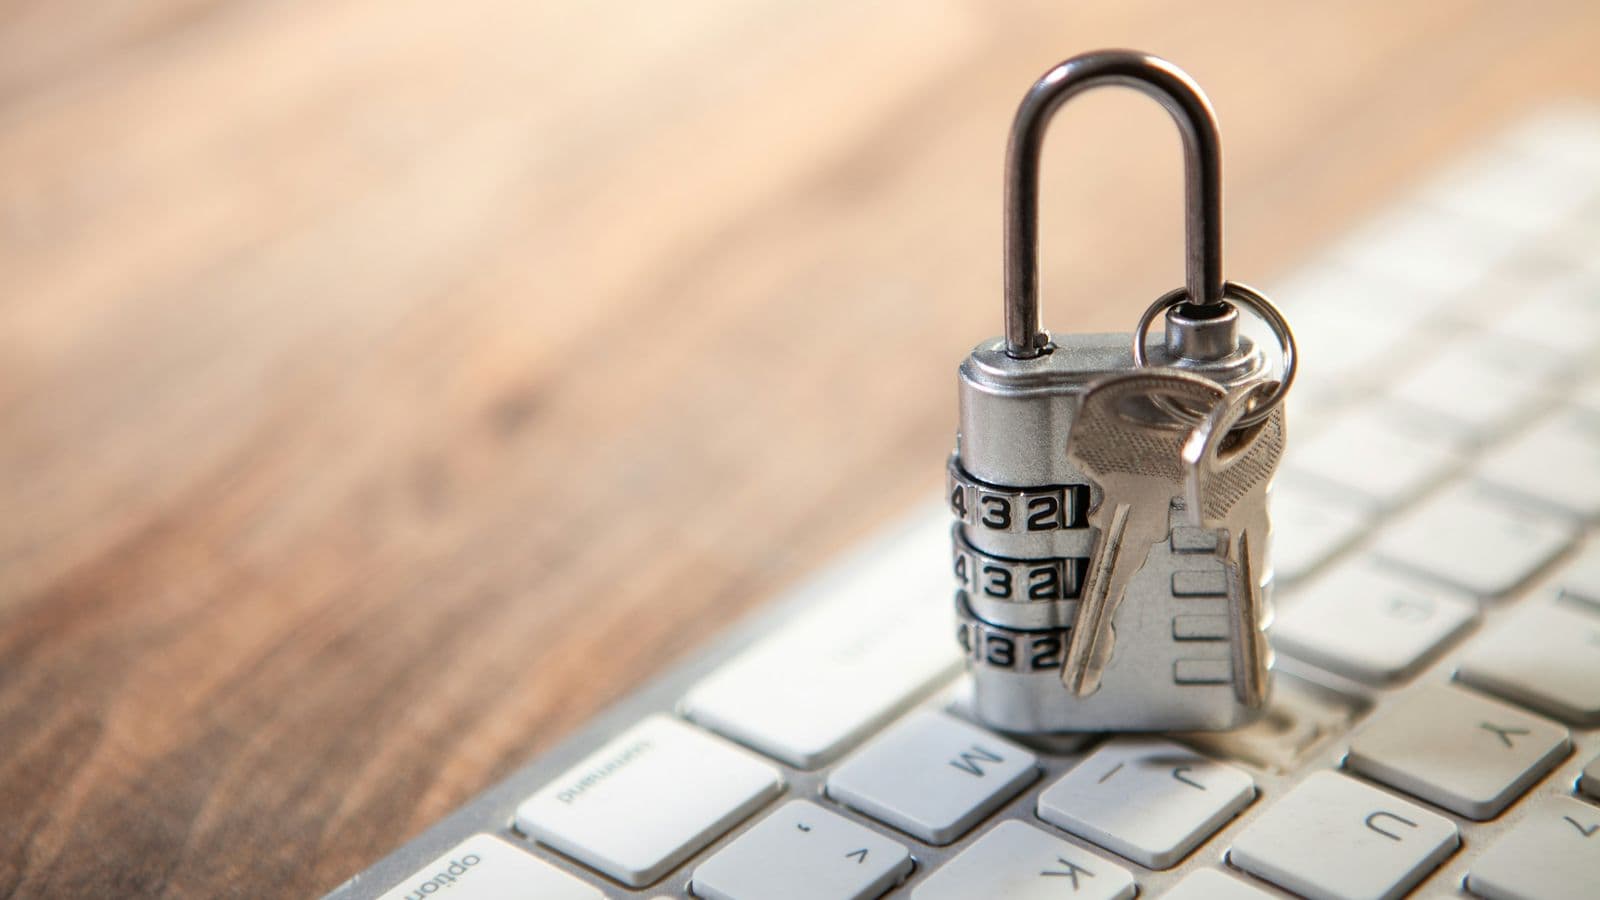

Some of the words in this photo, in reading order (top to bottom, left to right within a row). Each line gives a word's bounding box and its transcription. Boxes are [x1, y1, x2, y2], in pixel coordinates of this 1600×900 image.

[1479, 721, 1531, 748] Y
[949, 746, 1004, 778] M
[1171, 766, 1206, 791] J
[1364, 810, 1419, 842] U
[1039, 857, 1096, 892] K
